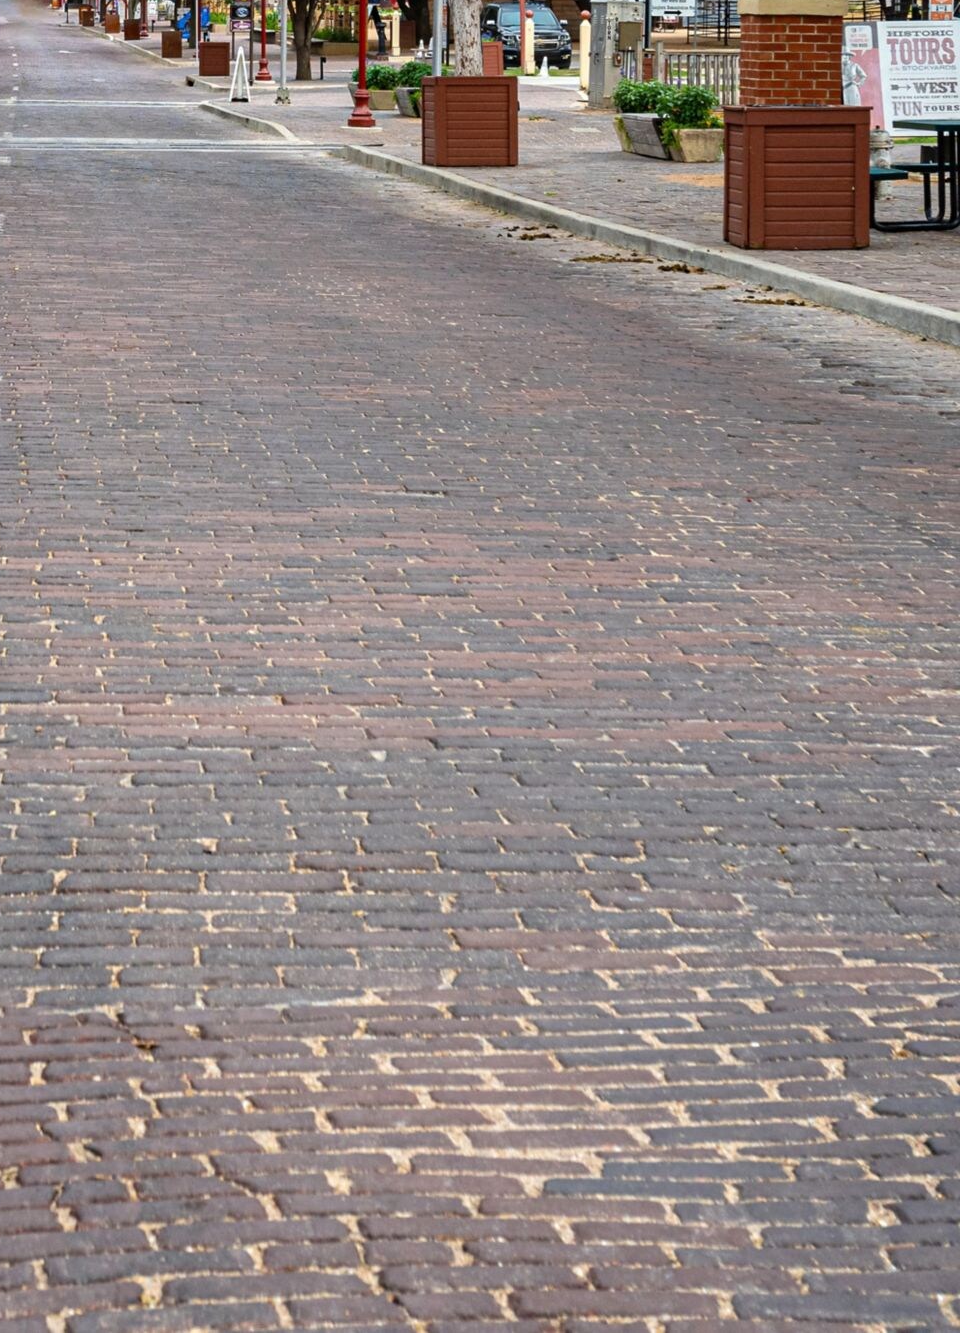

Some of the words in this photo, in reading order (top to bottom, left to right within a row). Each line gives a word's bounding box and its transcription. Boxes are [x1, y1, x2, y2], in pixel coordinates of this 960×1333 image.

[886, 37, 956, 66] TOURS
[913, 81, 958, 94] WEST
[891, 101, 923, 117] FUN
